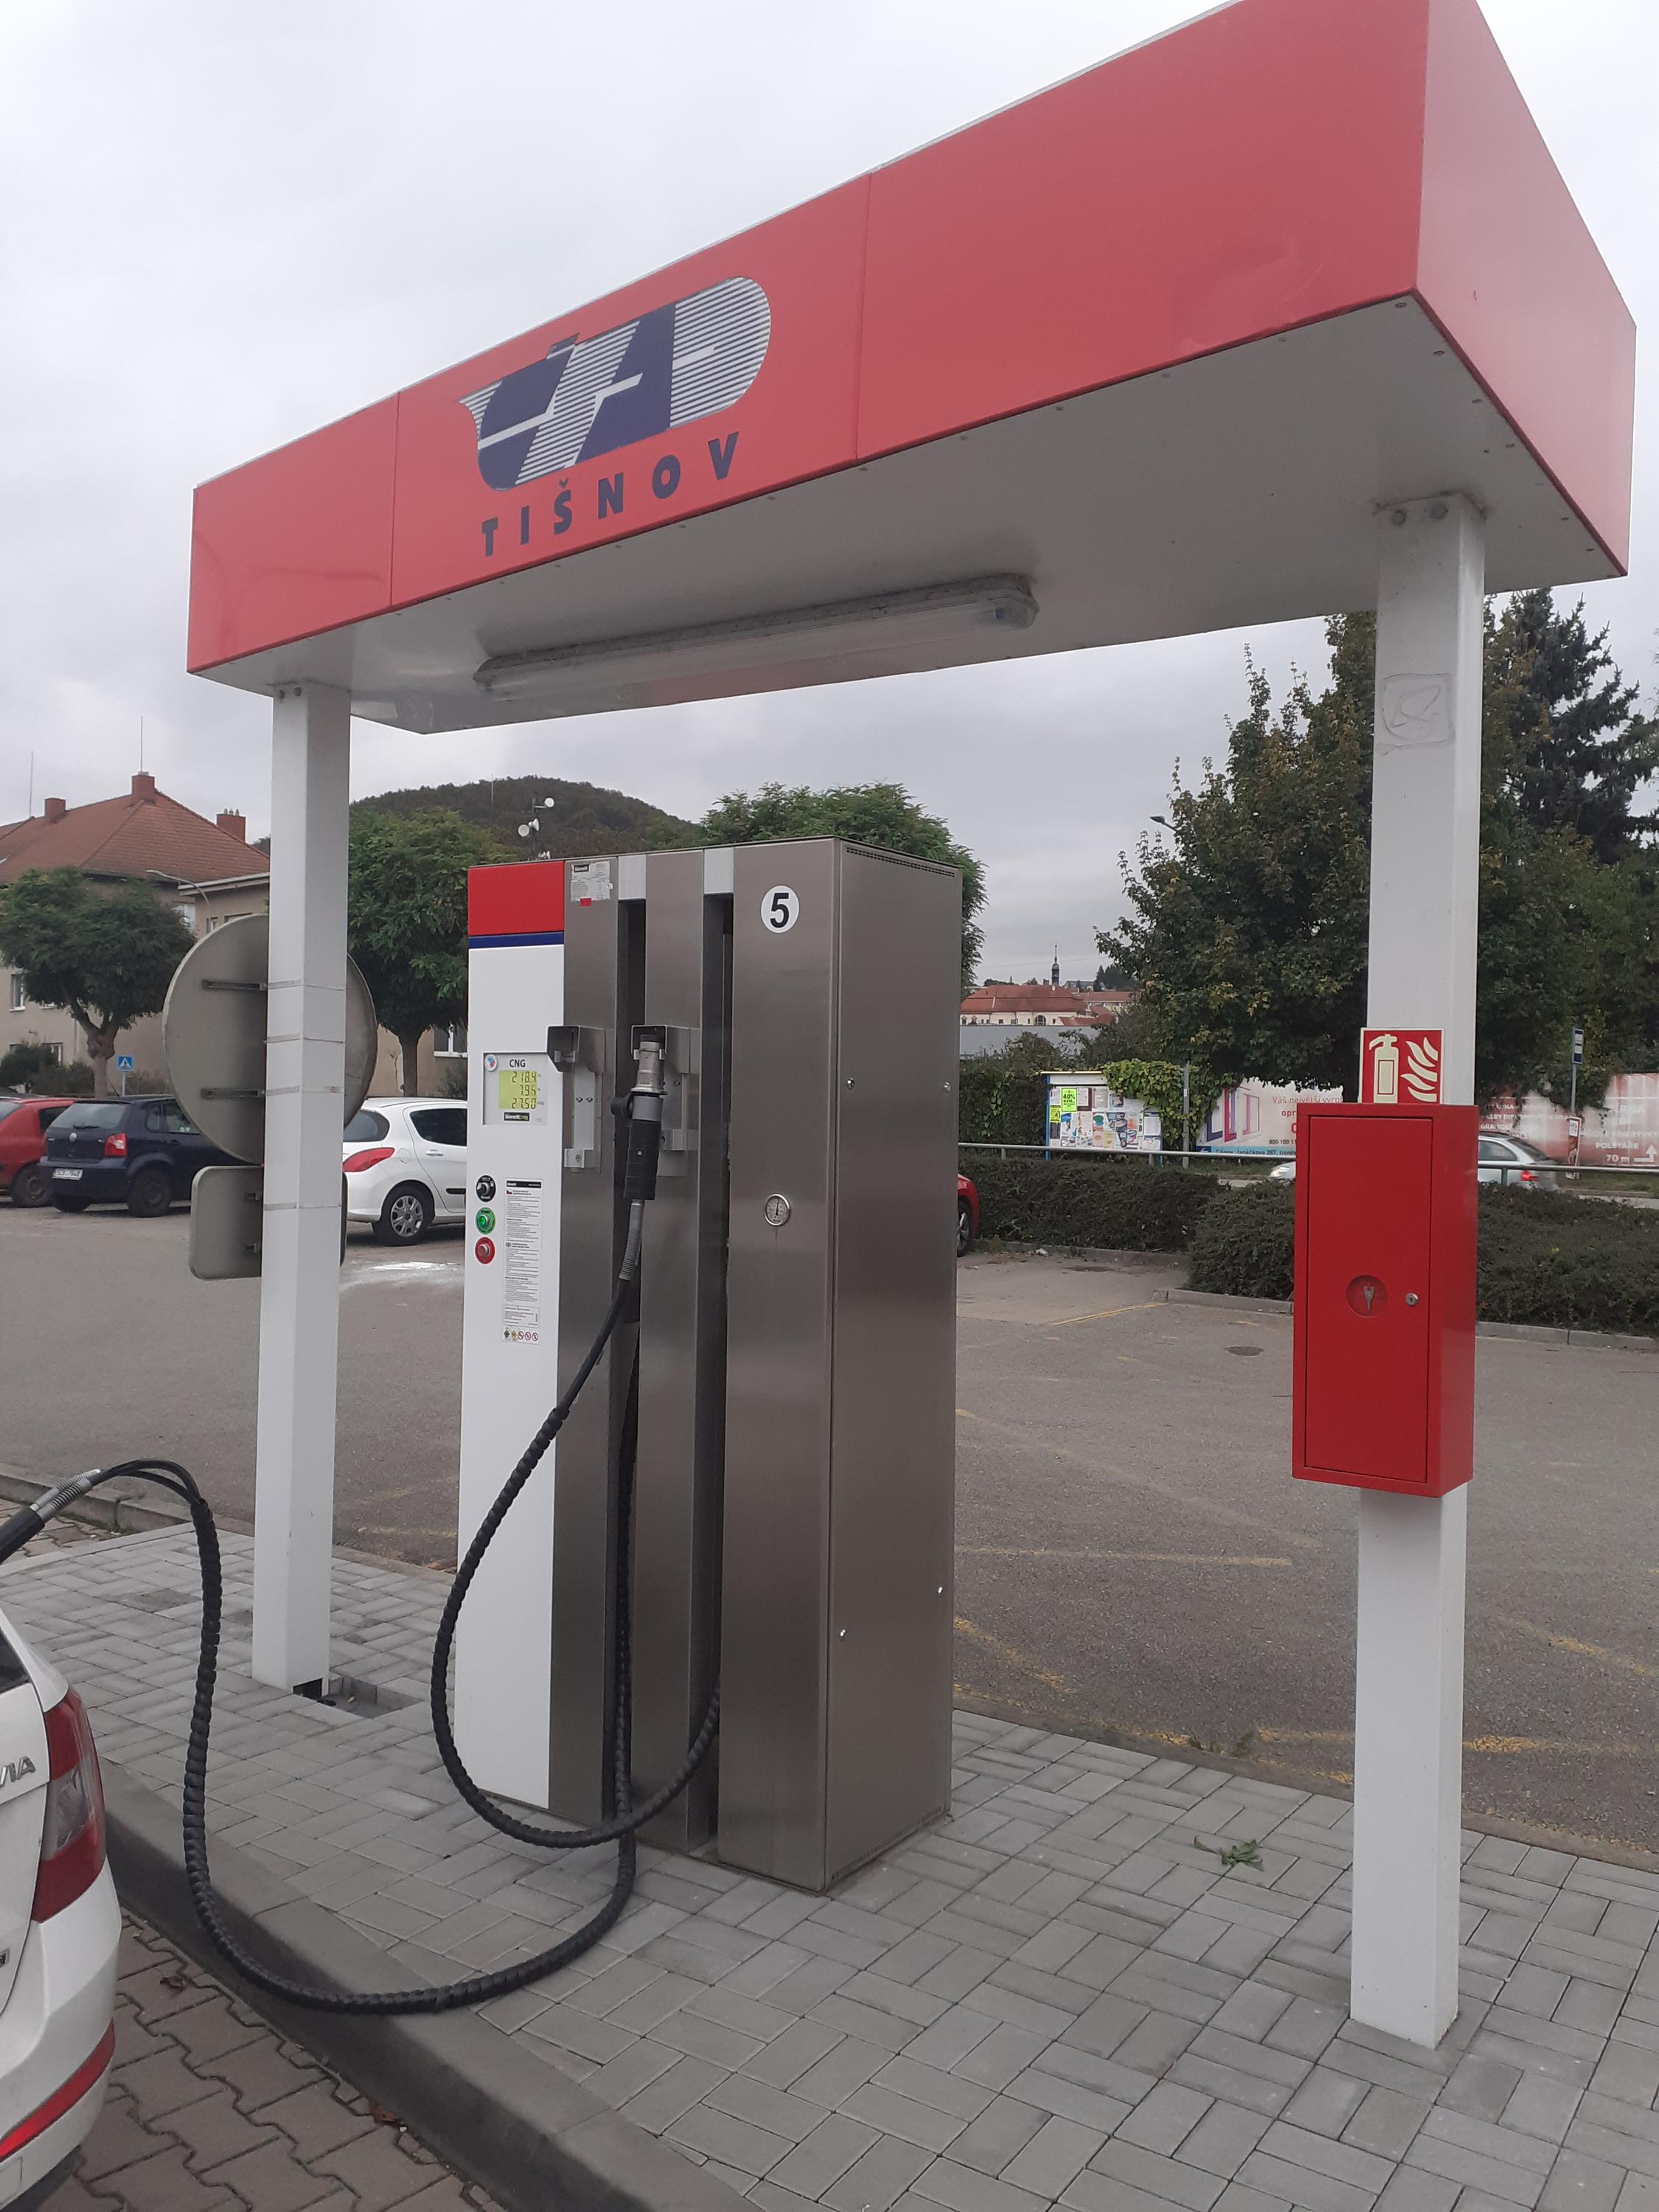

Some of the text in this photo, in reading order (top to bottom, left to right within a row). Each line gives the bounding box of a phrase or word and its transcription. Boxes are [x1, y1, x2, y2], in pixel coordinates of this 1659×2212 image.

[481, 431, 740, 557] TIŠNOV
[769, 892, 790, 928] 5
[509, 1059, 526, 1068] CNG
[1272, 1096, 1287, 1104] Váš
[1605, 1154, 1619, 1163] 70
